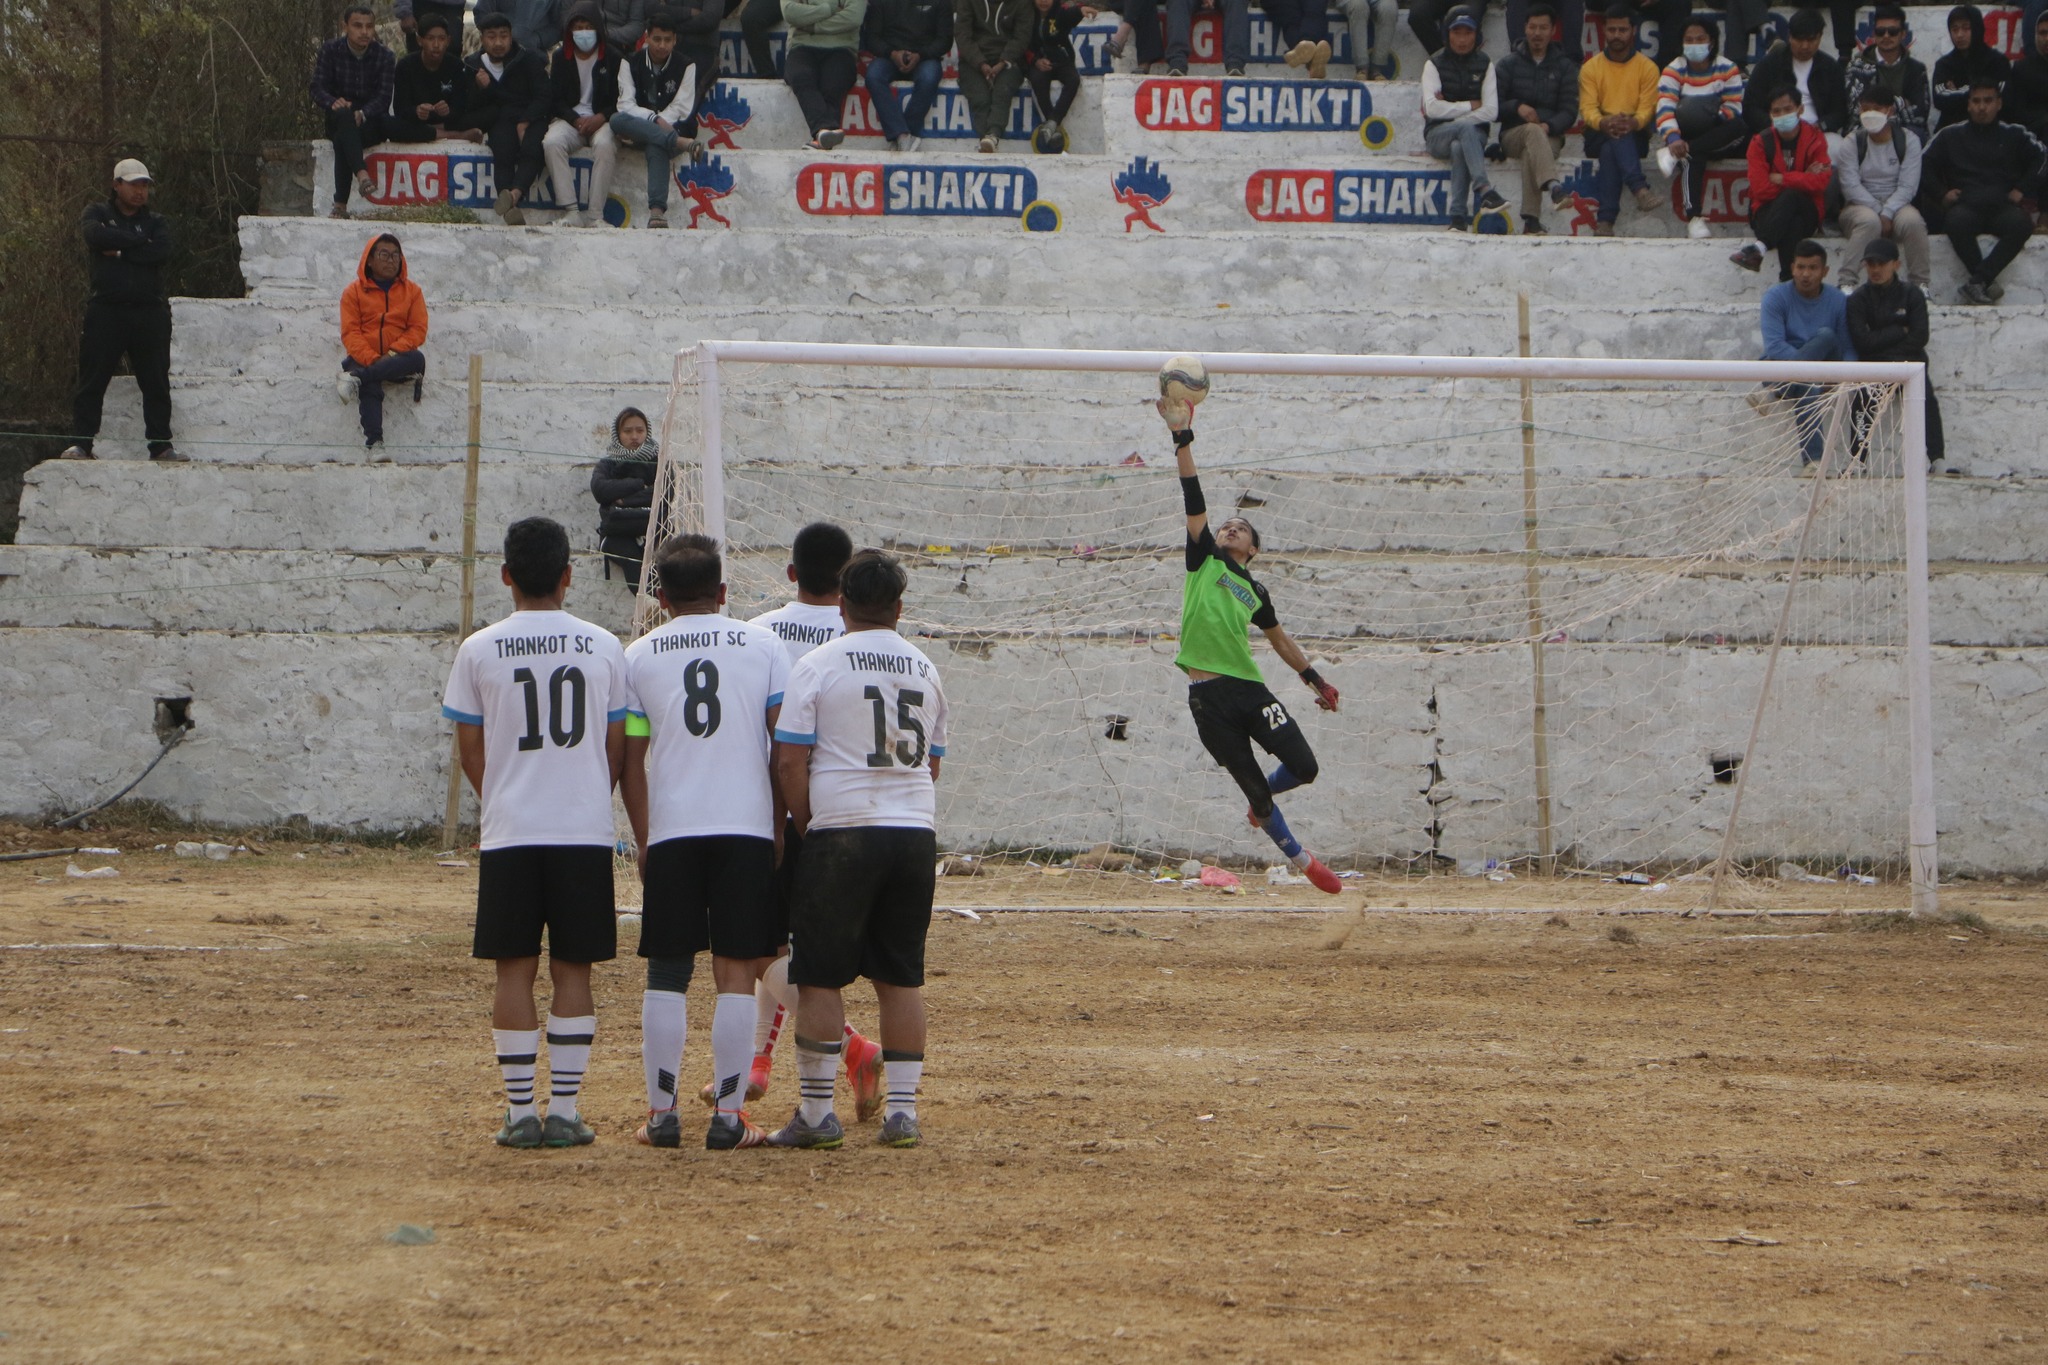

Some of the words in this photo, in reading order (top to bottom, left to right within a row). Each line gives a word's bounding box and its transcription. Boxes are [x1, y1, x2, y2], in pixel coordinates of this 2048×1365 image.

[1145, 87, 1214, 126] JAG
[1225, 86, 1362, 126] SHAKTI
[374, 160, 442, 201] JAG
[808, 169, 877, 211] JAG
[889, 169, 1024, 212] SHAKTI
[1256, 177, 1325, 217] JAG
[495, 634, 569, 660] THANKOT
[574, 634, 594, 656] SC
[651, 631, 722, 655] THANKOT
[727, 630, 747, 648] SC
[771, 622, 835, 646] THANKOT
[846, 651, 914, 676] THANKOT
[918, 661, 932, 681] SC
[513, 665, 587, 752] 10
[683, 658, 722, 740] 8
[1262, 702, 1288, 731] 23
[863, 684, 926, 770] 15
